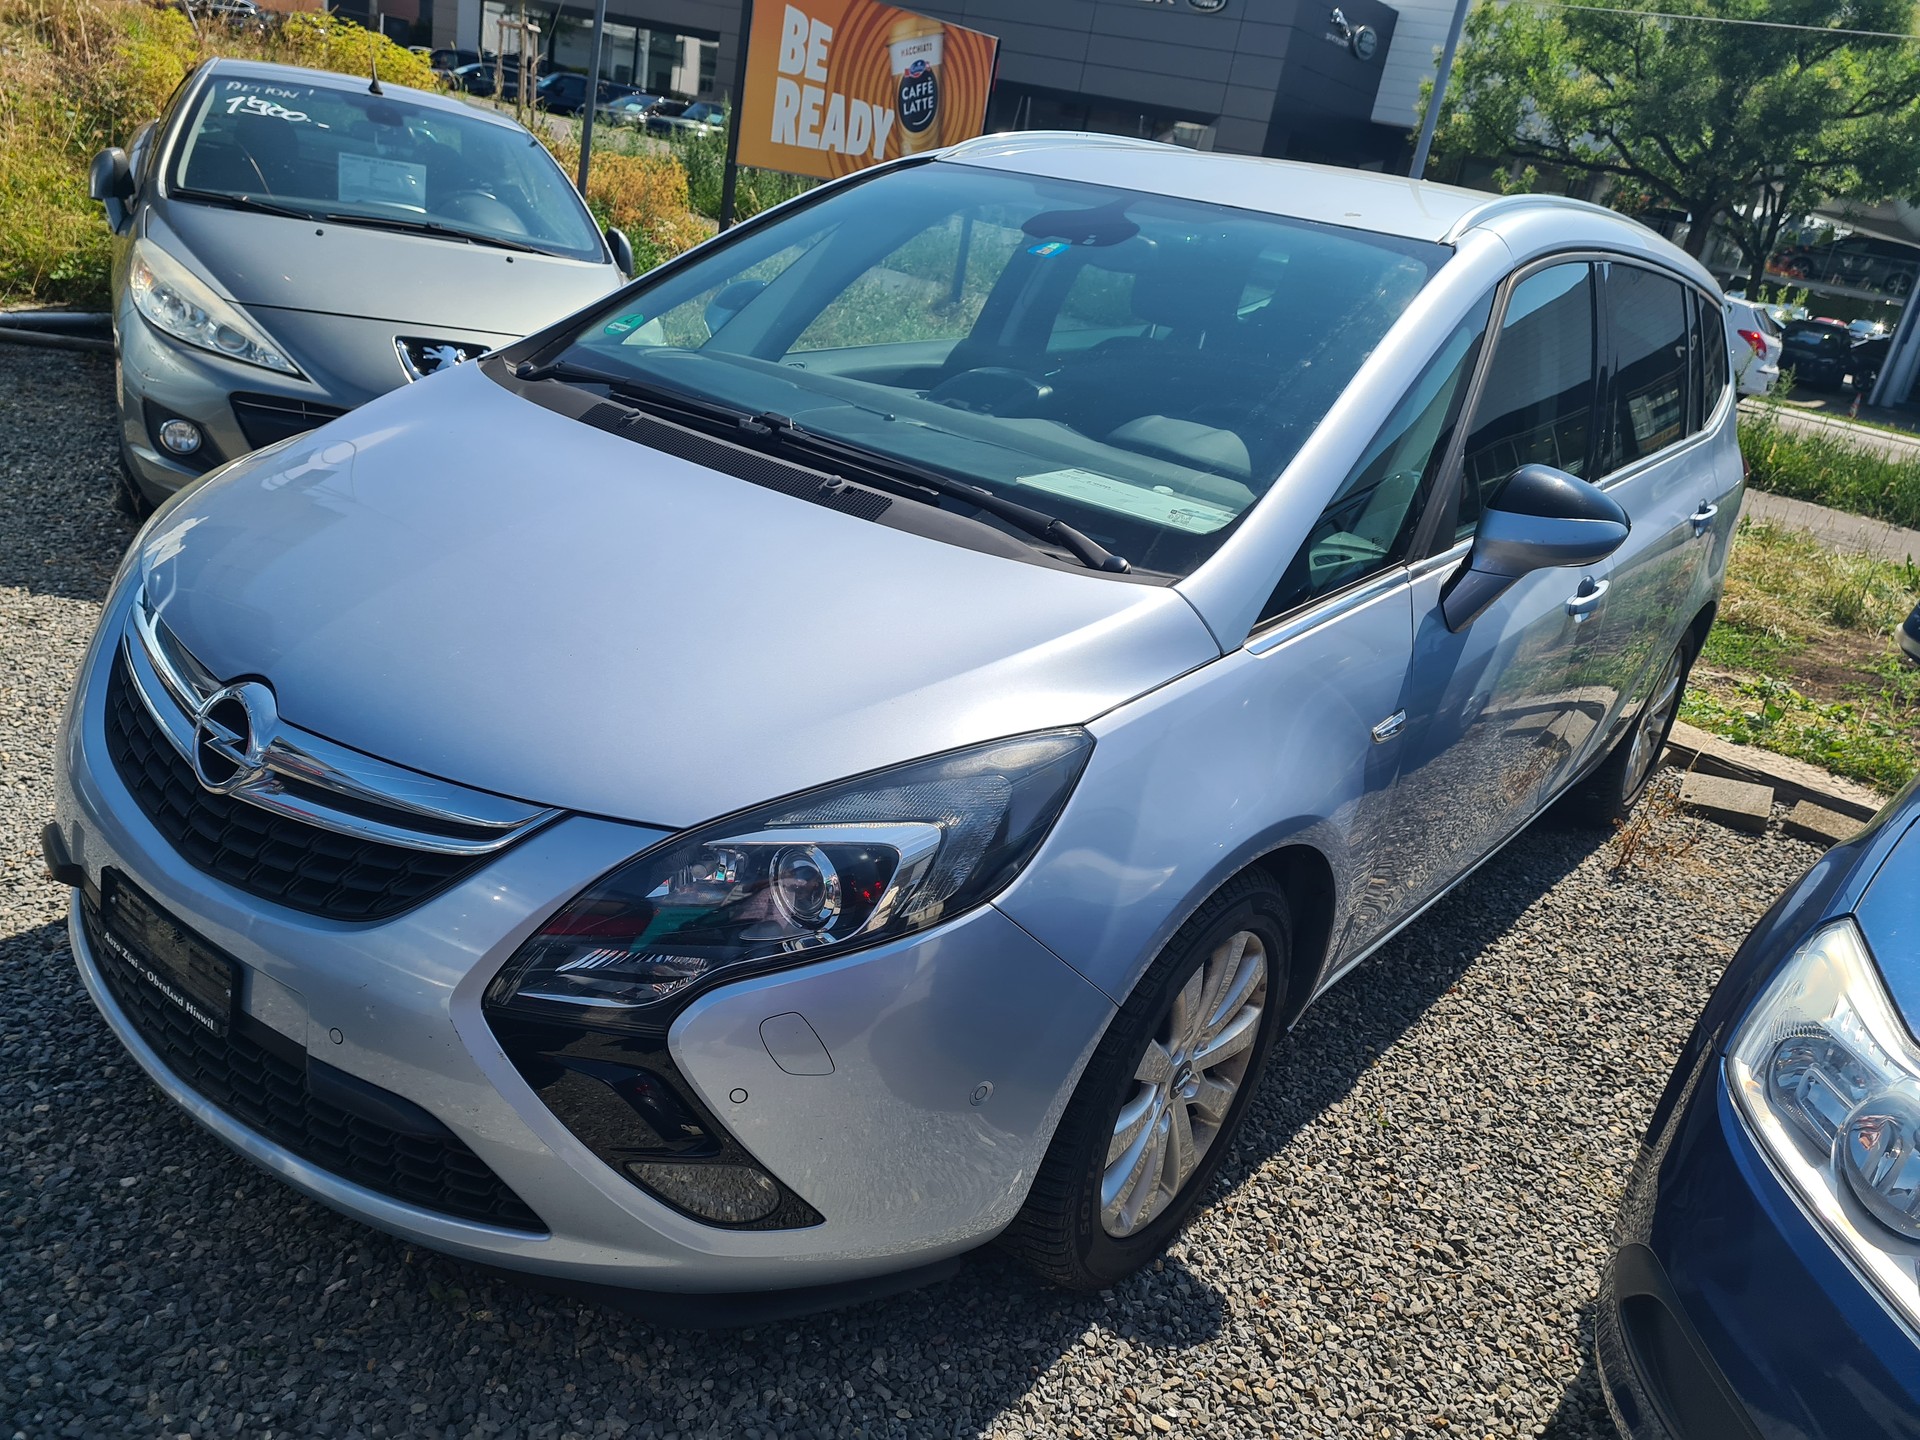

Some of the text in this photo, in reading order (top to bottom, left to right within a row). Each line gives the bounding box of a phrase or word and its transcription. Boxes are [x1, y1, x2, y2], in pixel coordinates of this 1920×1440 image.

[778, 4, 833, 83] BE
[901, 42, 932, 57] MACCHIATO
[902, 77, 933, 100] CAFFÈ
[903, 96, 933, 116] LATTE
[771, 76, 895, 160] READY
